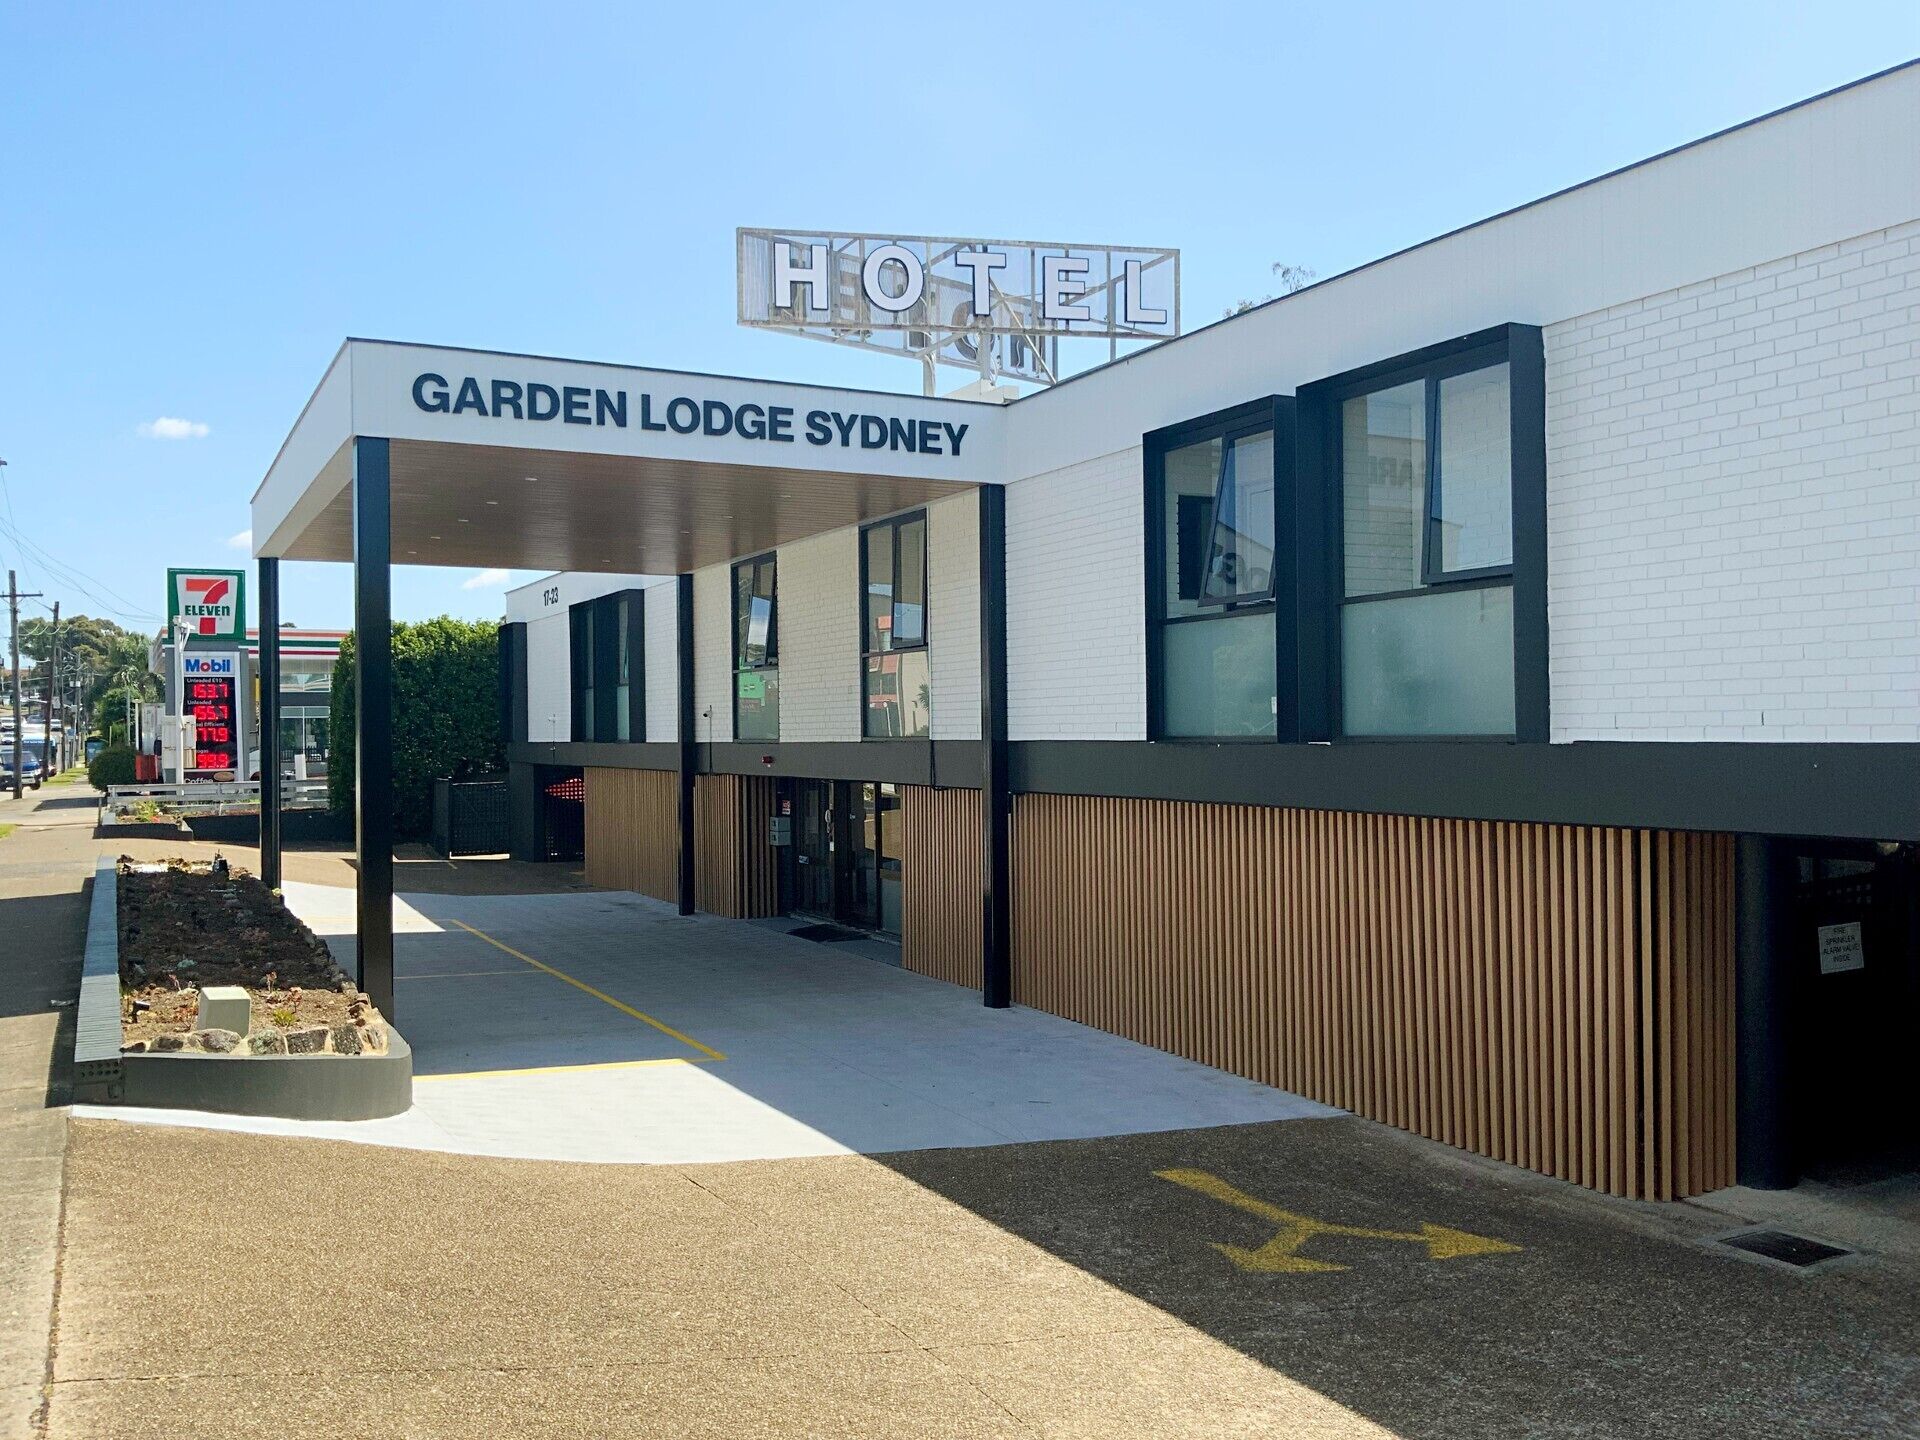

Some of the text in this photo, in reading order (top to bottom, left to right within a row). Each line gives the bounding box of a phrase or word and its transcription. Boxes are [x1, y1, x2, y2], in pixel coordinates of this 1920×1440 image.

[773, 242, 1167, 325] HOTEL
[411, 372, 969, 456] GARDEN LODGE SYDNEY
[543, 586, 559, 607] 17-23
[186, 578, 229, 635] 7
[185, 658, 231, 673] Mobil
[193, 683, 228, 698] 153.7
[193, 705, 228, 720] 155.7
[1825, 935, 1856, 945] SPRINKLER
